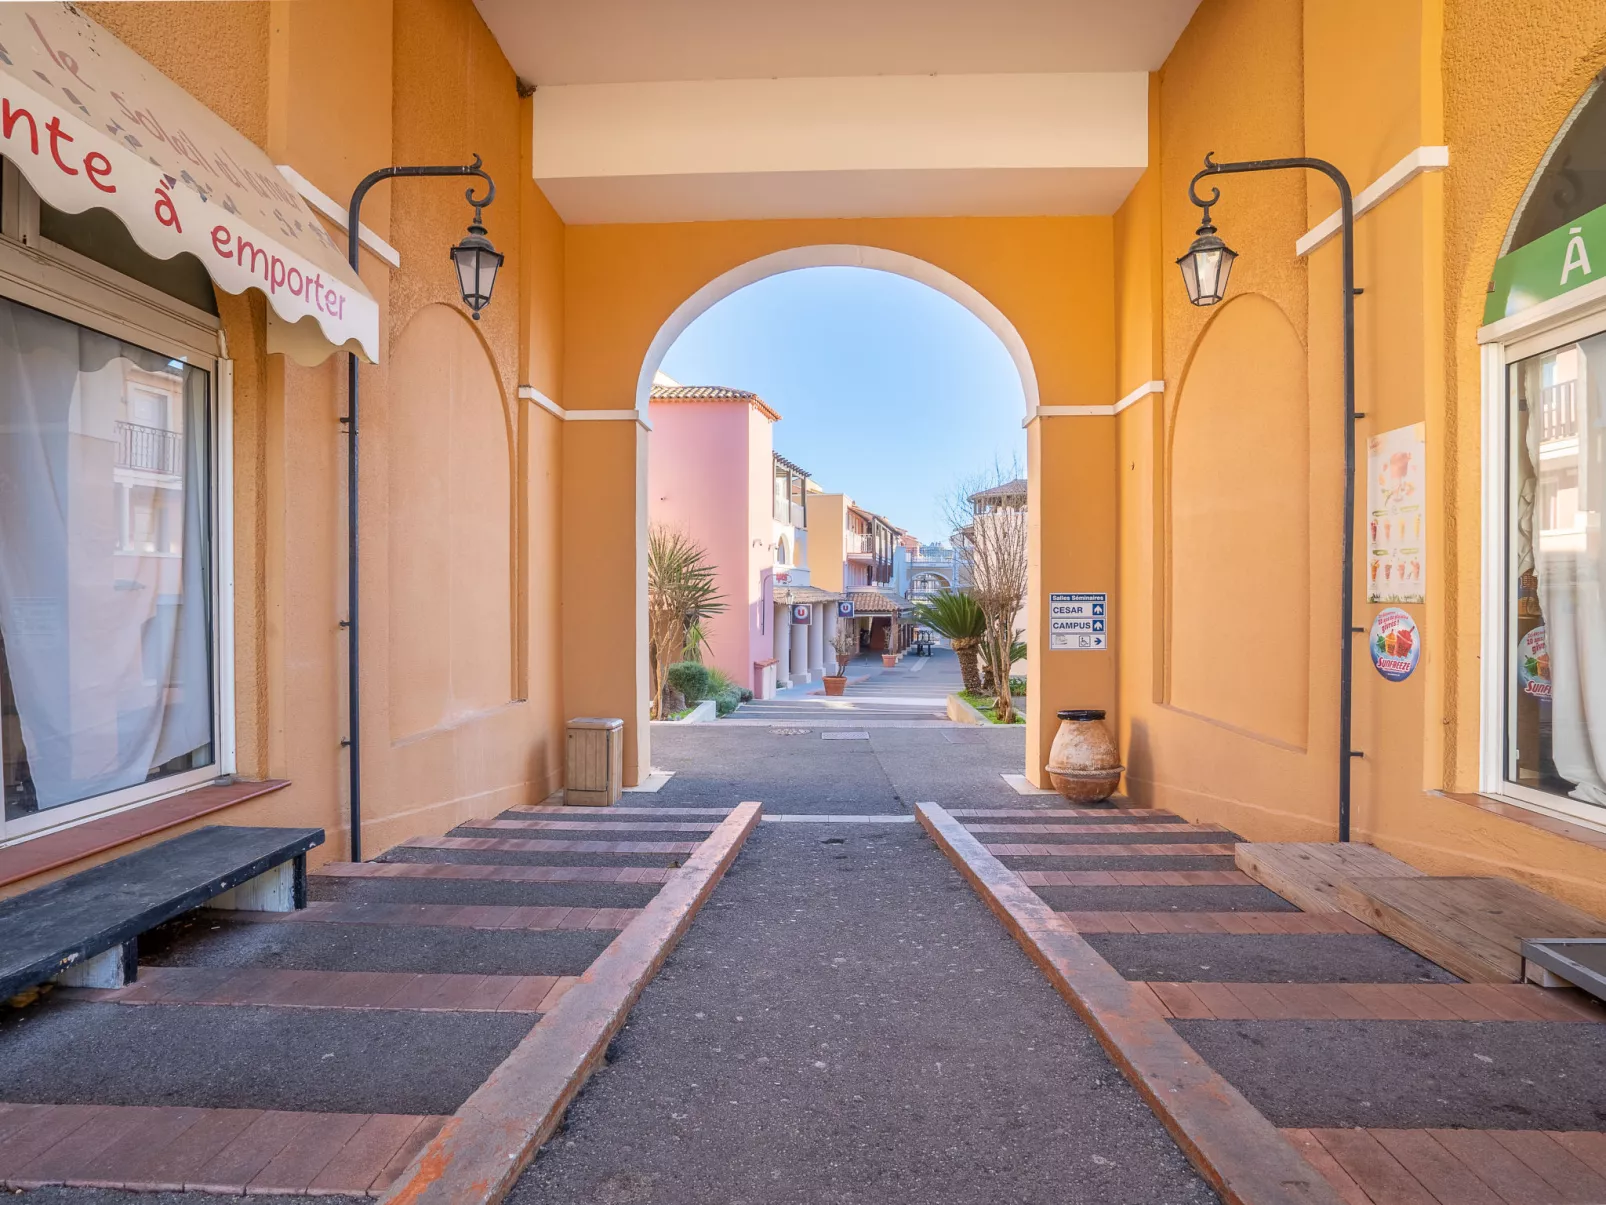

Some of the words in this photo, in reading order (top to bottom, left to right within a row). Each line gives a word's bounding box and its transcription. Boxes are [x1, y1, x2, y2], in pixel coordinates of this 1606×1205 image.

[2, 97, 117, 194] nte
[154, 178, 183, 235] à
[210, 224, 346, 321] emporter
[1053, 606, 1083, 614] CESAR
[1053, 622, 1091, 630] CAMPUS
